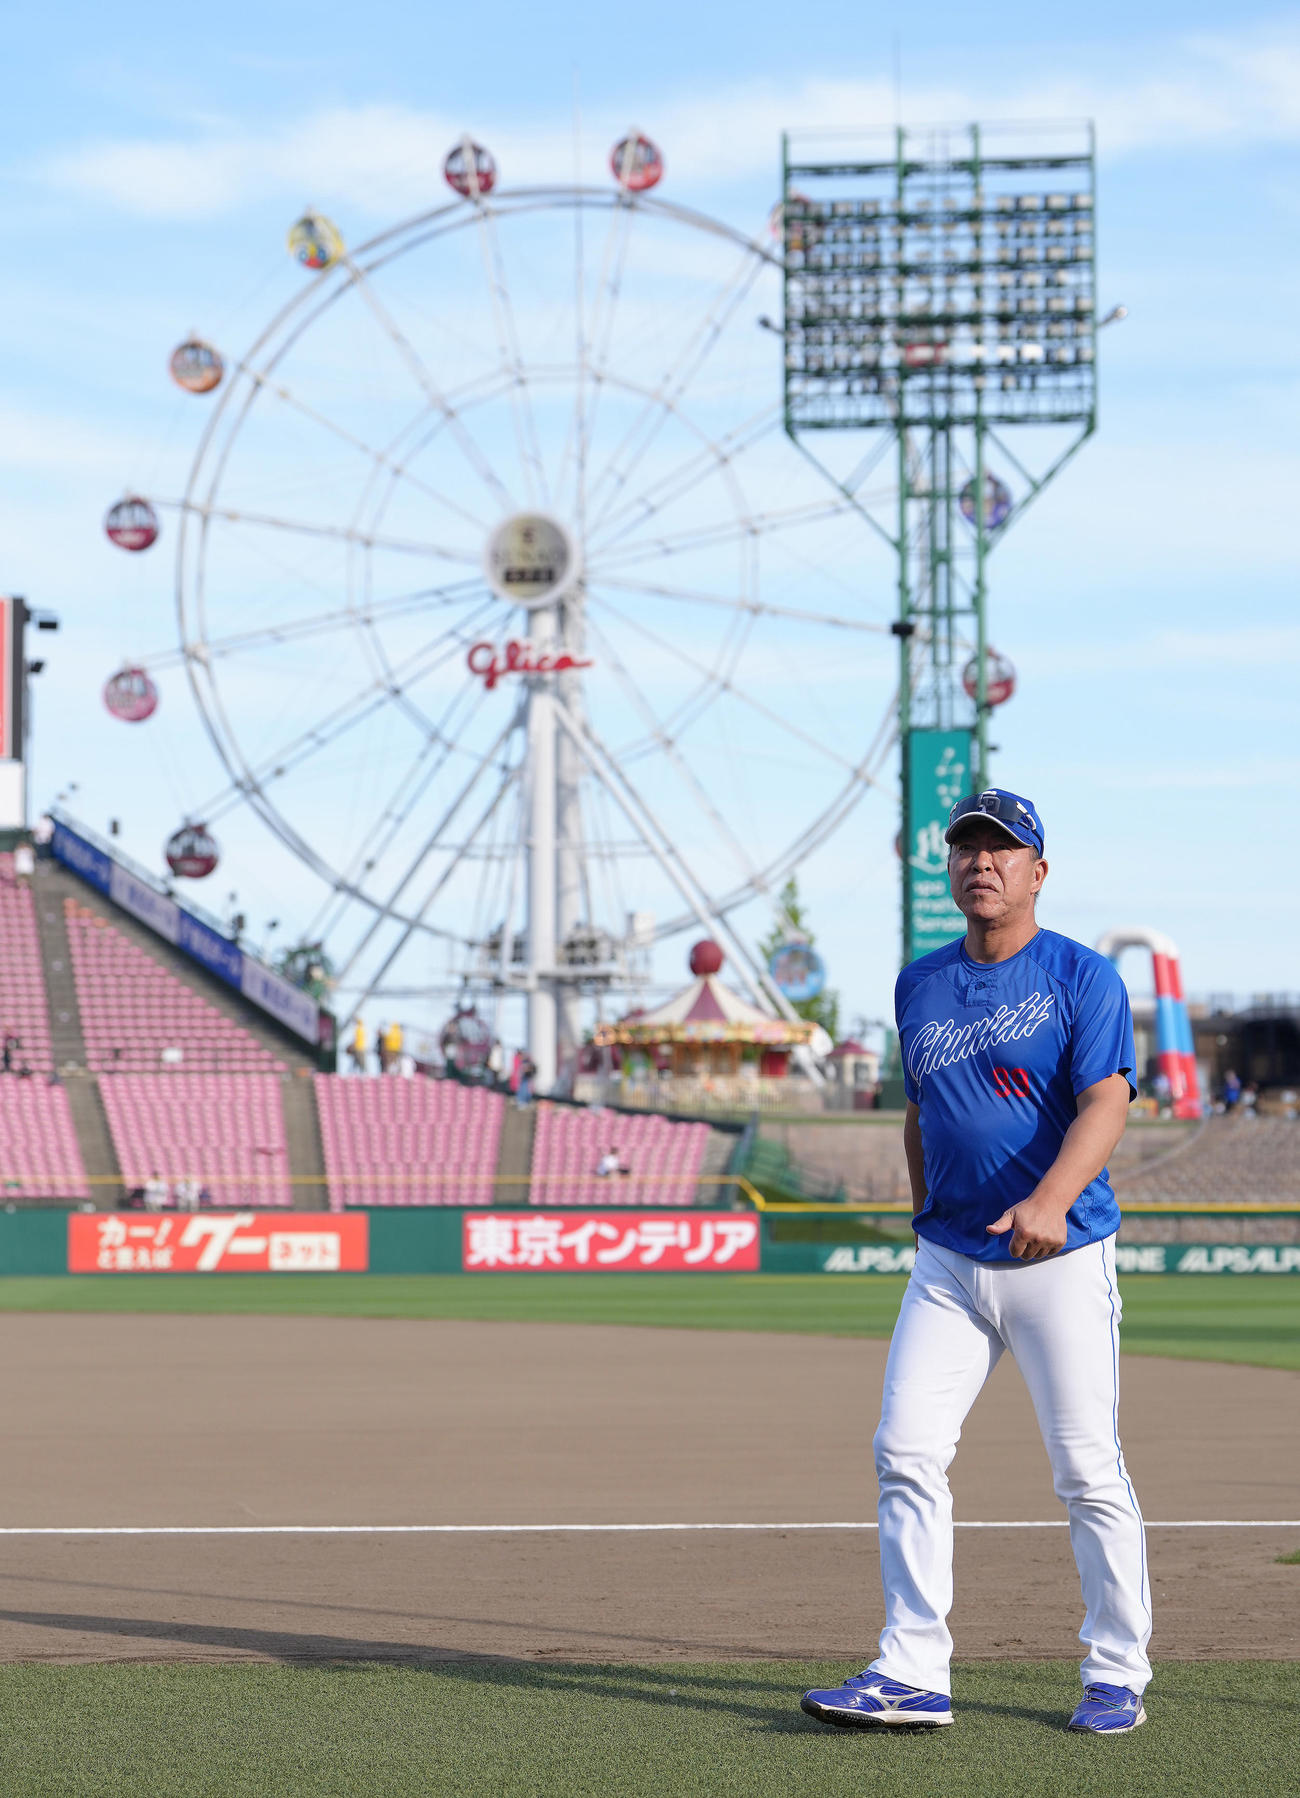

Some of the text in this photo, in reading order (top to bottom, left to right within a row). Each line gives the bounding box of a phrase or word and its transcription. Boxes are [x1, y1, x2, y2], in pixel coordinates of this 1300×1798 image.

[468, 640, 593, 690] Glico
[993, 1067, 1029, 1098] 99
[467, 1215, 756, 1266] 東京インテリア
[1116, 1246, 1166, 1272] INE
